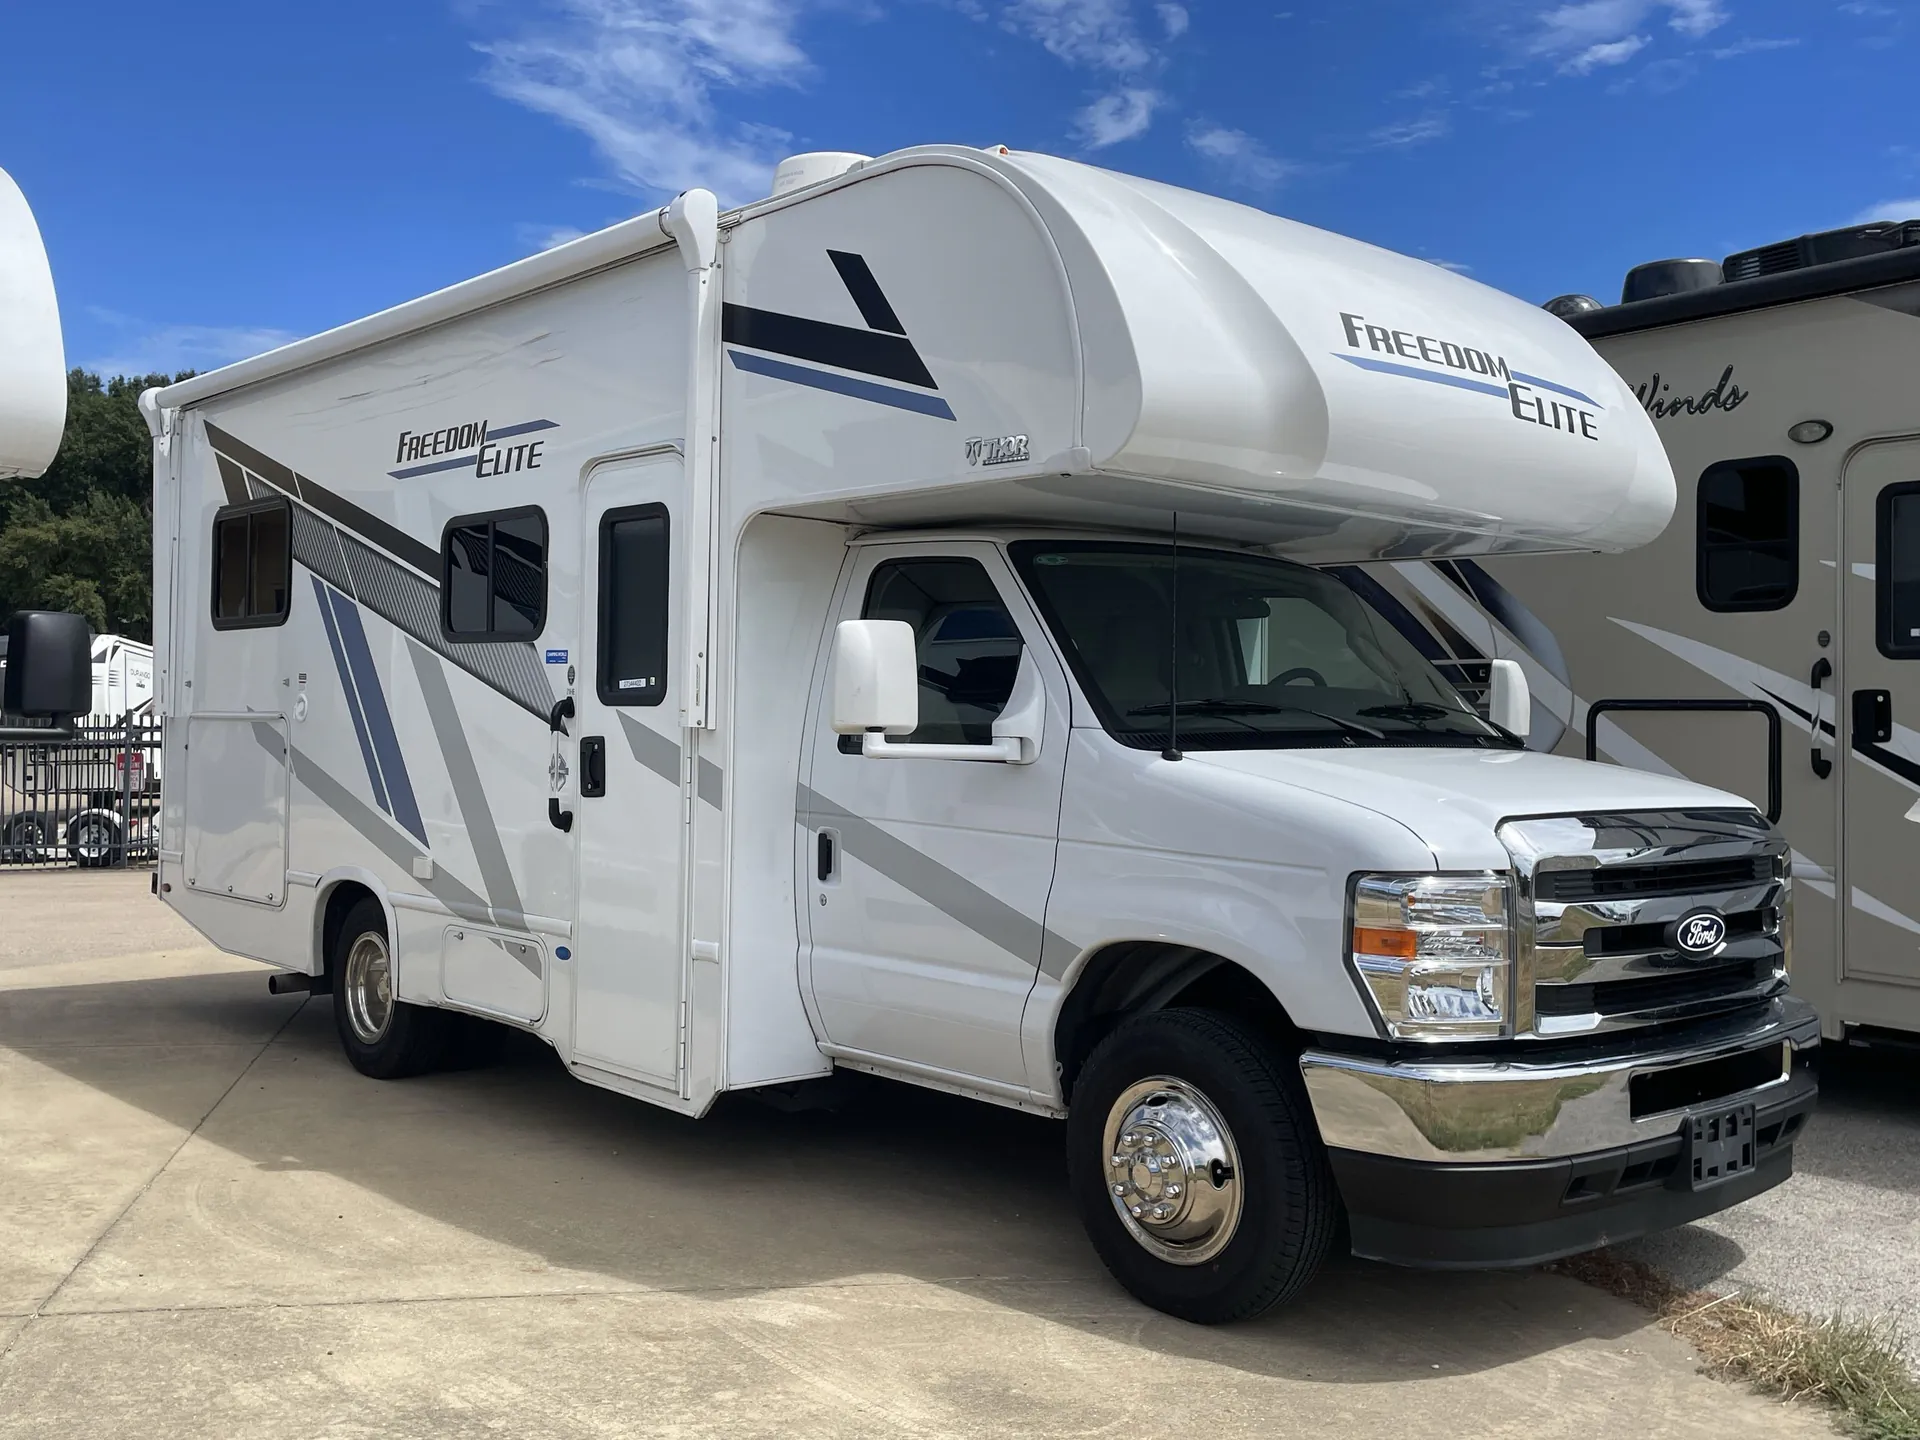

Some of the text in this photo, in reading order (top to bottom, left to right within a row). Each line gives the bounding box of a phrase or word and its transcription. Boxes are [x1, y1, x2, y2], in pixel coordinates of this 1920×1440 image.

[1339, 311, 1512, 382] FREEDOM
[1508, 382, 1599, 441] ELITE
[396, 420, 488, 463] FREEDOM
[476, 441, 544, 478] ELITE
[983, 434, 1029, 459] THOR
[1687, 920, 1717, 946] Ford
